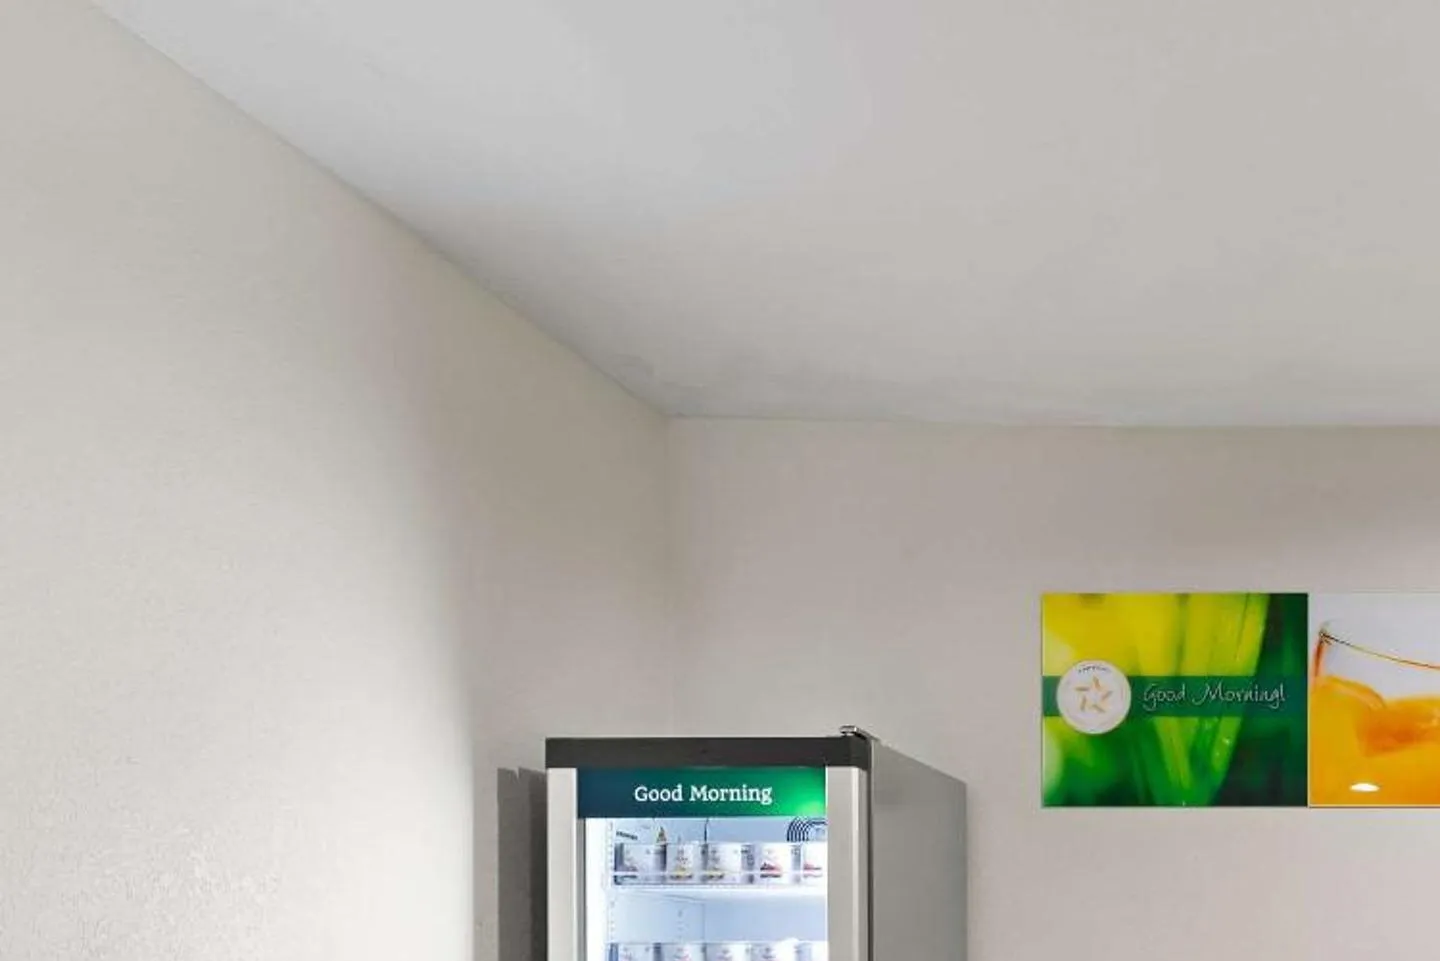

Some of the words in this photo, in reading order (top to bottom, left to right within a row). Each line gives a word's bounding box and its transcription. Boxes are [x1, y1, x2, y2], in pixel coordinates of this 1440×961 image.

[1143, 683, 1186, 711] Good
[1192, 682, 1285, 709] Morning!
[634, 783, 684, 802] Good
[689, 783, 773, 805] Morning
